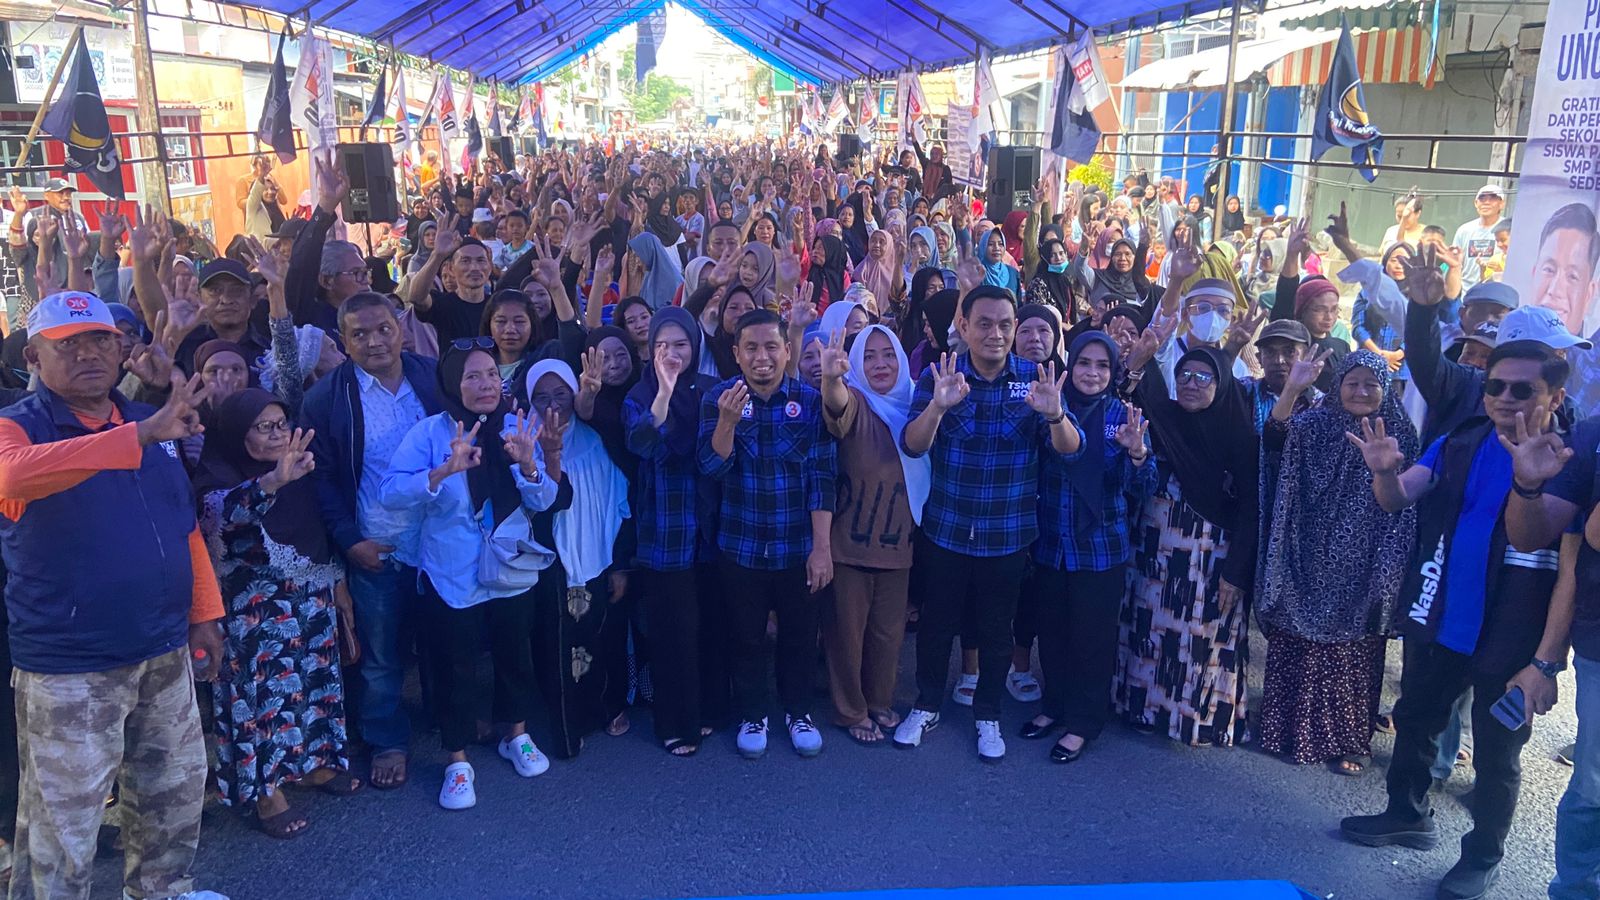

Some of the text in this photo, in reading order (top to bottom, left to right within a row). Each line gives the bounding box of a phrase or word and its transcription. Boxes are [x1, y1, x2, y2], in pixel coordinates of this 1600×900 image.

[441, 115, 456, 132] 10
[1547, 113, 1576, 128] DAN
[1543, 143, 1600, 159] SISWA P
[1563, 160, 1591, 174] SMP
[69, 310, 93, 318] PKS
[1007, 381, 1031, 390] TSM
[1408, 533, 1445, 625] NasDe
